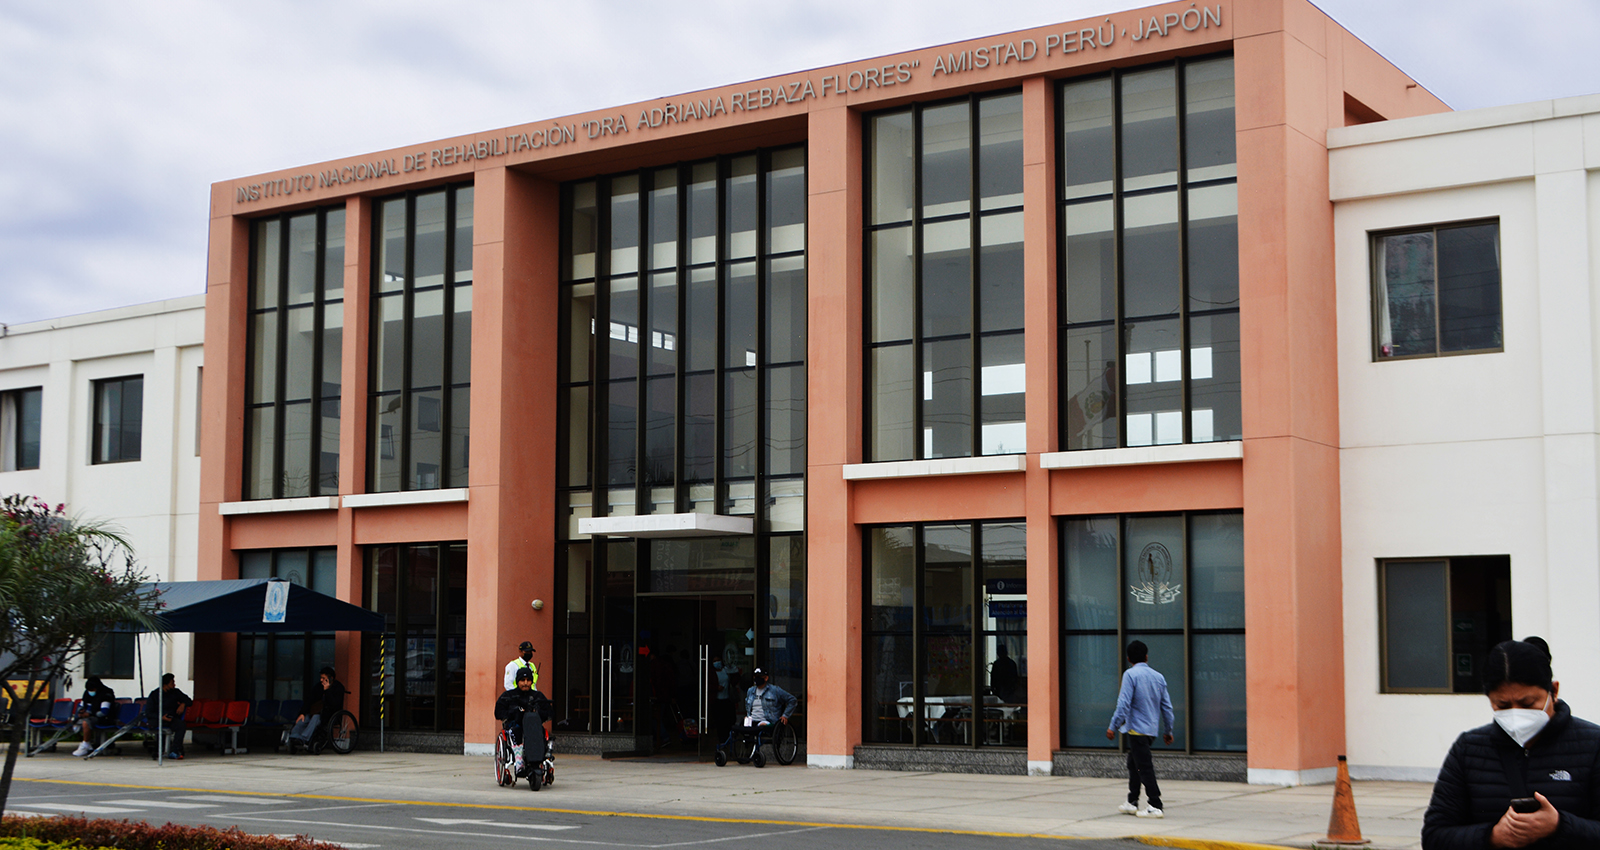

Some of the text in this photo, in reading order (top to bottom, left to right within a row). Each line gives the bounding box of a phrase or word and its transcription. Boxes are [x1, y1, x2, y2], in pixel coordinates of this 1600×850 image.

[236, 174, 314, 203] INSTITUTO
[318, 157, 400, 188] NACIONAL
[402, 151, 427, 172] DE
[636, 95, 728, 129] ADRIANA
[731, 80, 817, 113] REBAZA
[821, 59, 920, 96] FLORES"
[931, 38, 1038, 77] AMISTAD
[1045, 17, 1115, 57] PERÚ
[1131, 2, 1222, 42] JAPÓN
